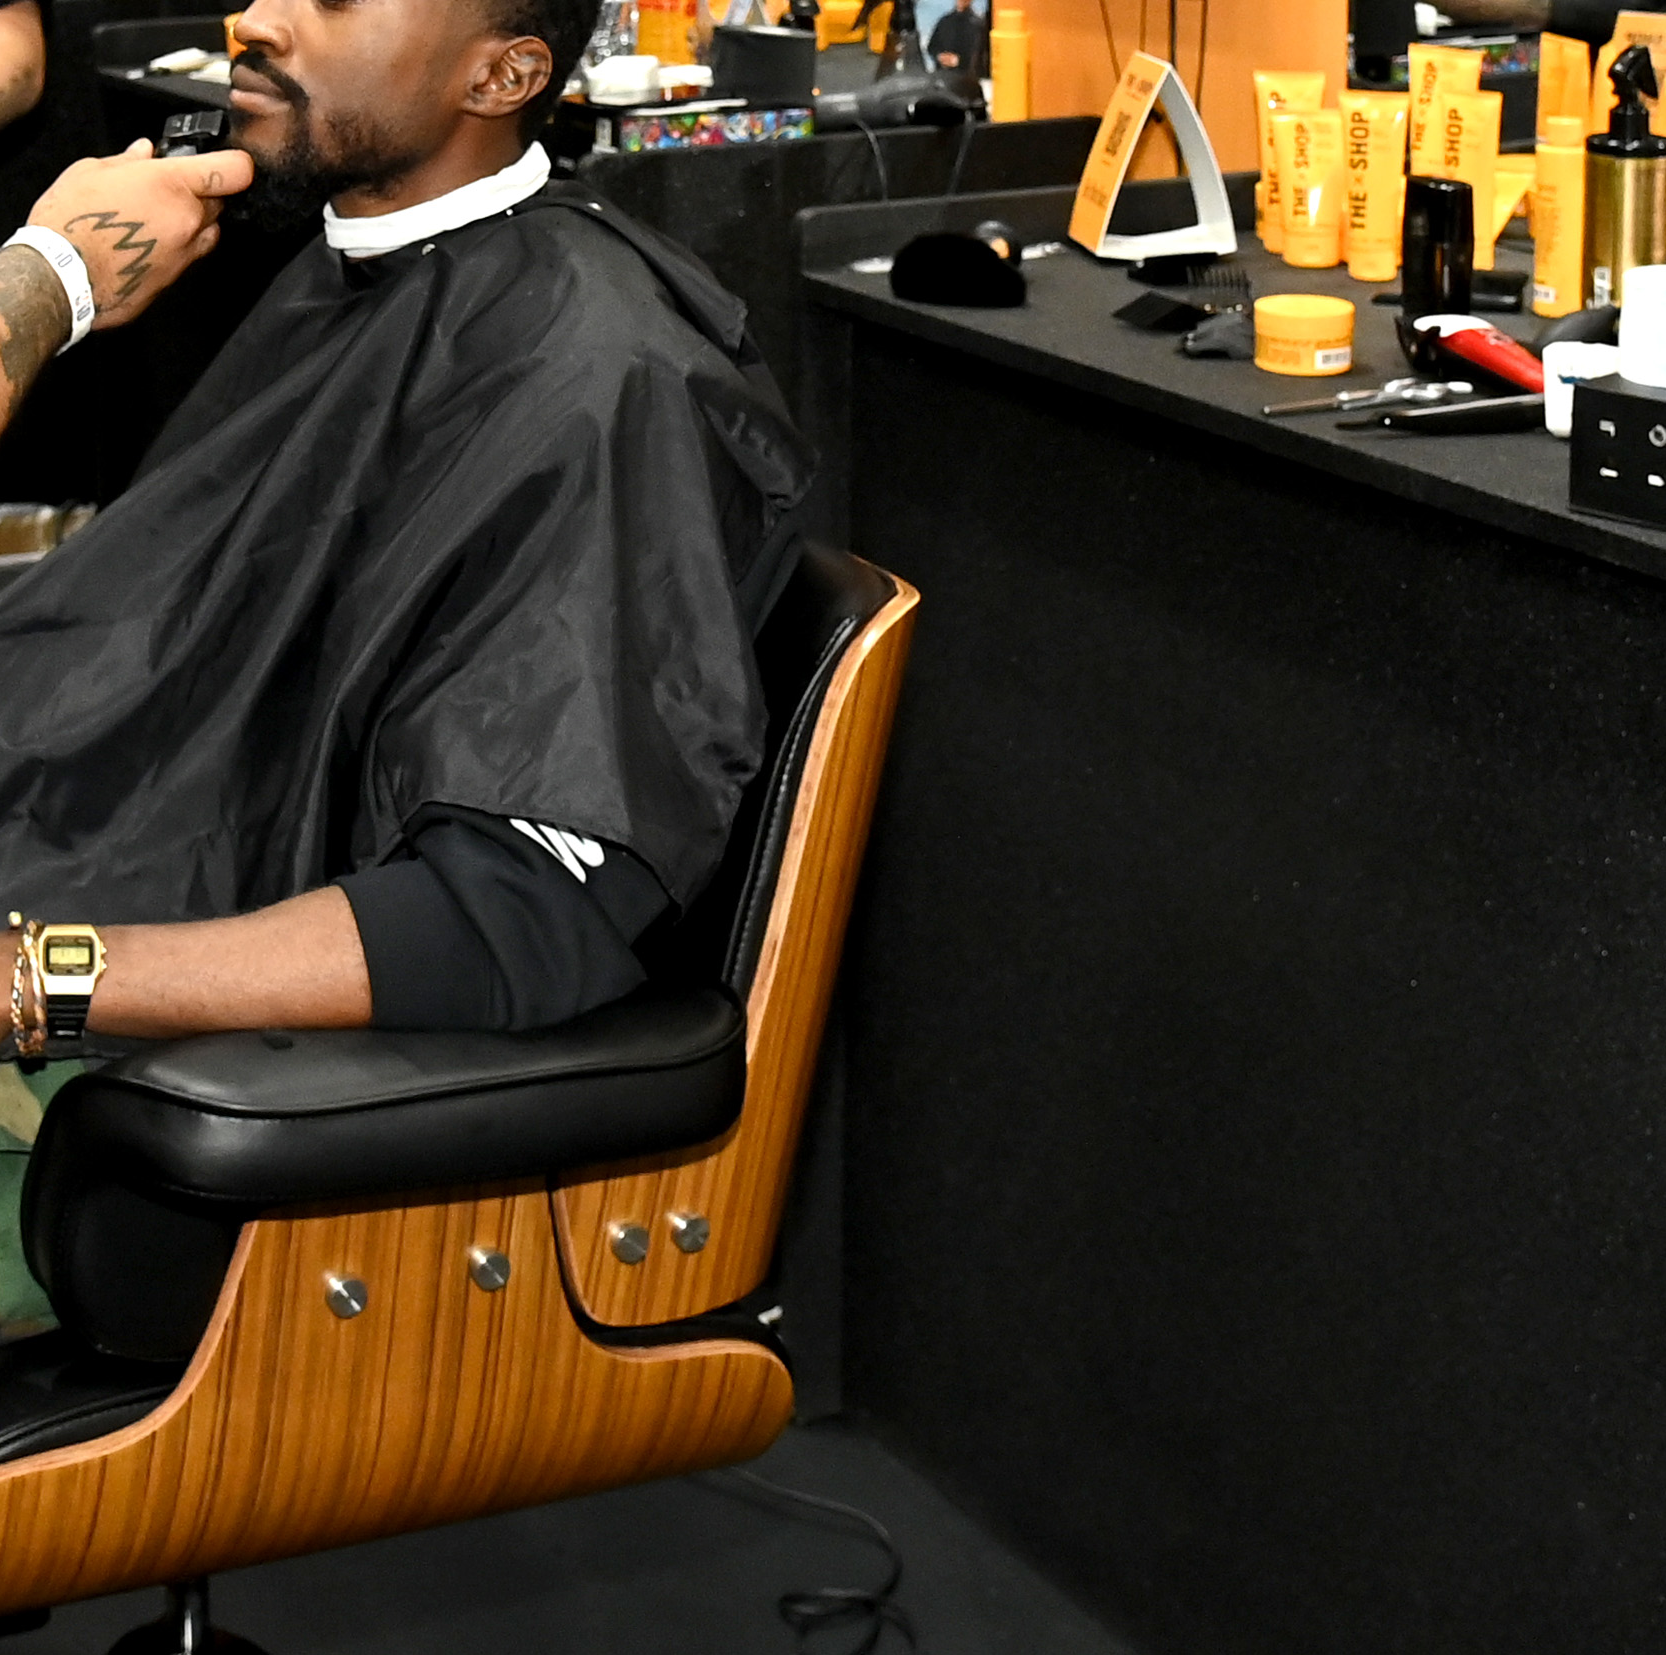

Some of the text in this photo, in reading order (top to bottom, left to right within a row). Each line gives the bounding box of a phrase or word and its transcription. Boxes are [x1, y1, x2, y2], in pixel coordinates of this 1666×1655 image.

[1294, 122, 1310, 169] SHOP
[1445, 108, 1464, 167] SHOP
[1348, 111, 1370, 230] THE SHOP
